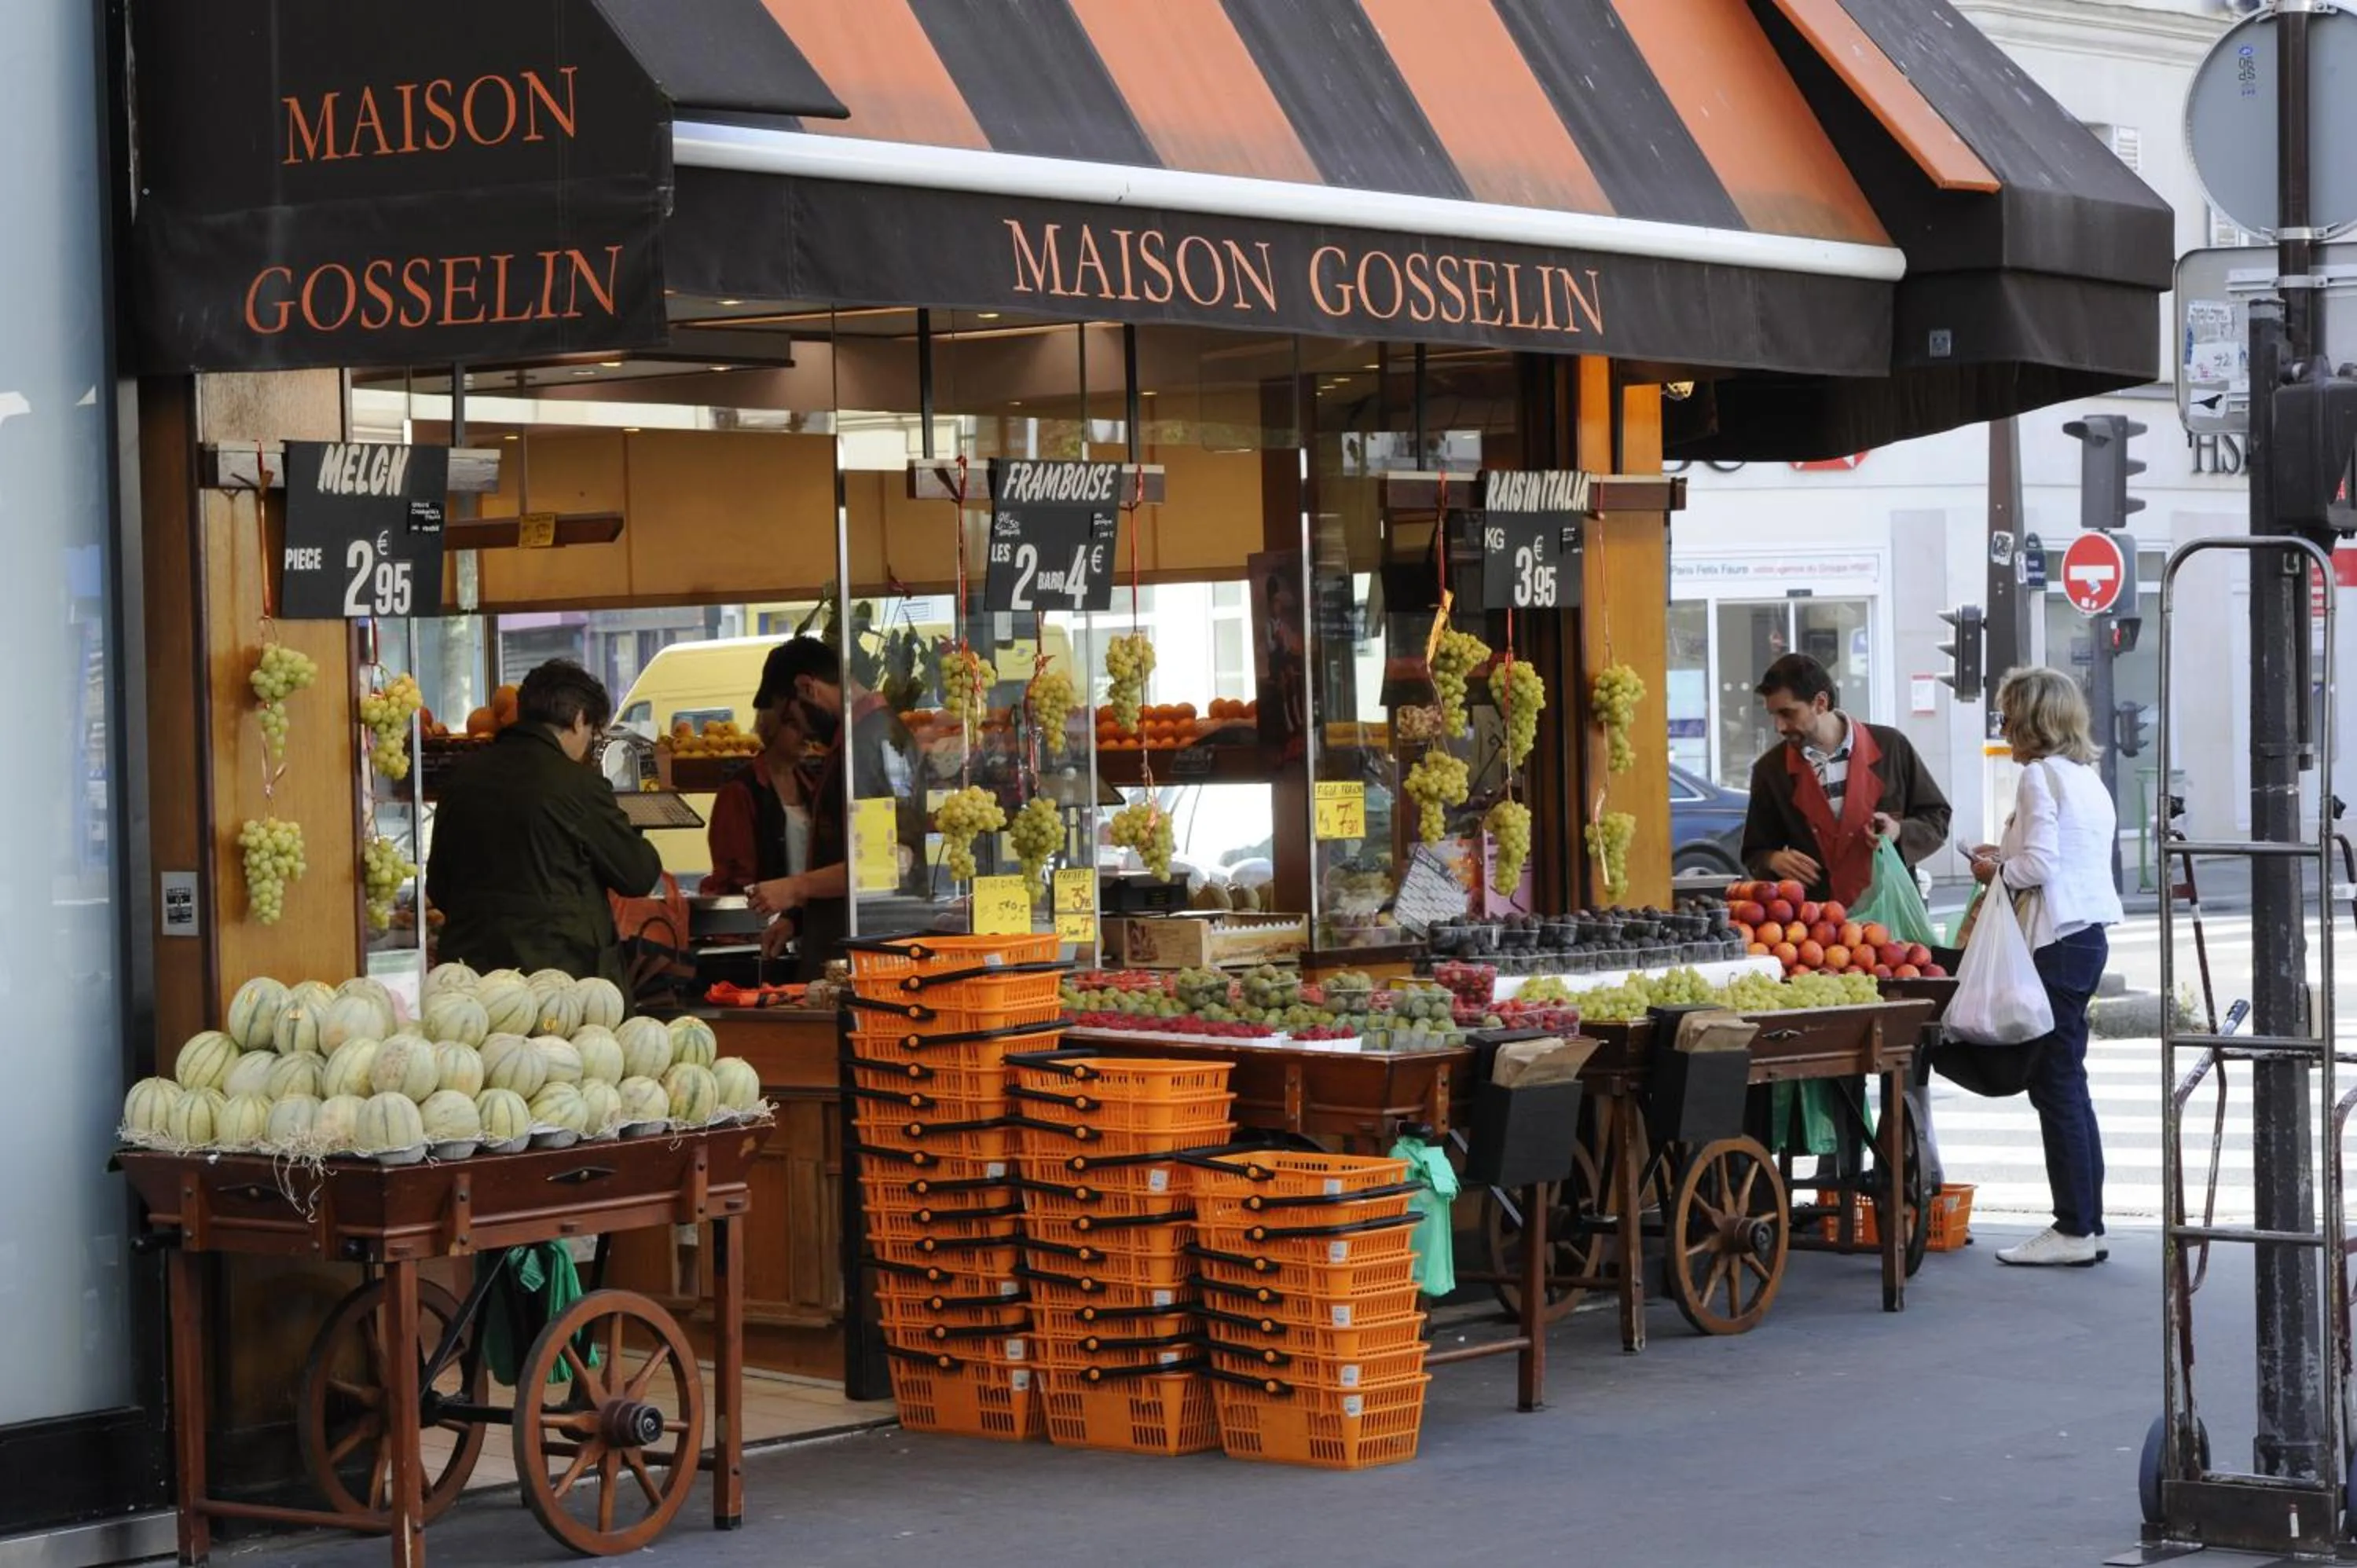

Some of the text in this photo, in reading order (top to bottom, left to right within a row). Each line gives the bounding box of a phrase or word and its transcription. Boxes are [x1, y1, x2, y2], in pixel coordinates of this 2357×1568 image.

[281, 66, 577, 164] MAISON
[245, 245, 623, 334] GOSSELIN
[1003, 219, 1604, 335] MAISON GOSSELIN
[317, 443, 411, 496] MELON
[1002, 461, 1117, 503] FRAMBOISE
[284, 548, 323, 570] PIECE
[1484, 527, 1505, 550] KG
[991, 543, 1011, 562] LES
[1010, 543, 1039, 610] 2
